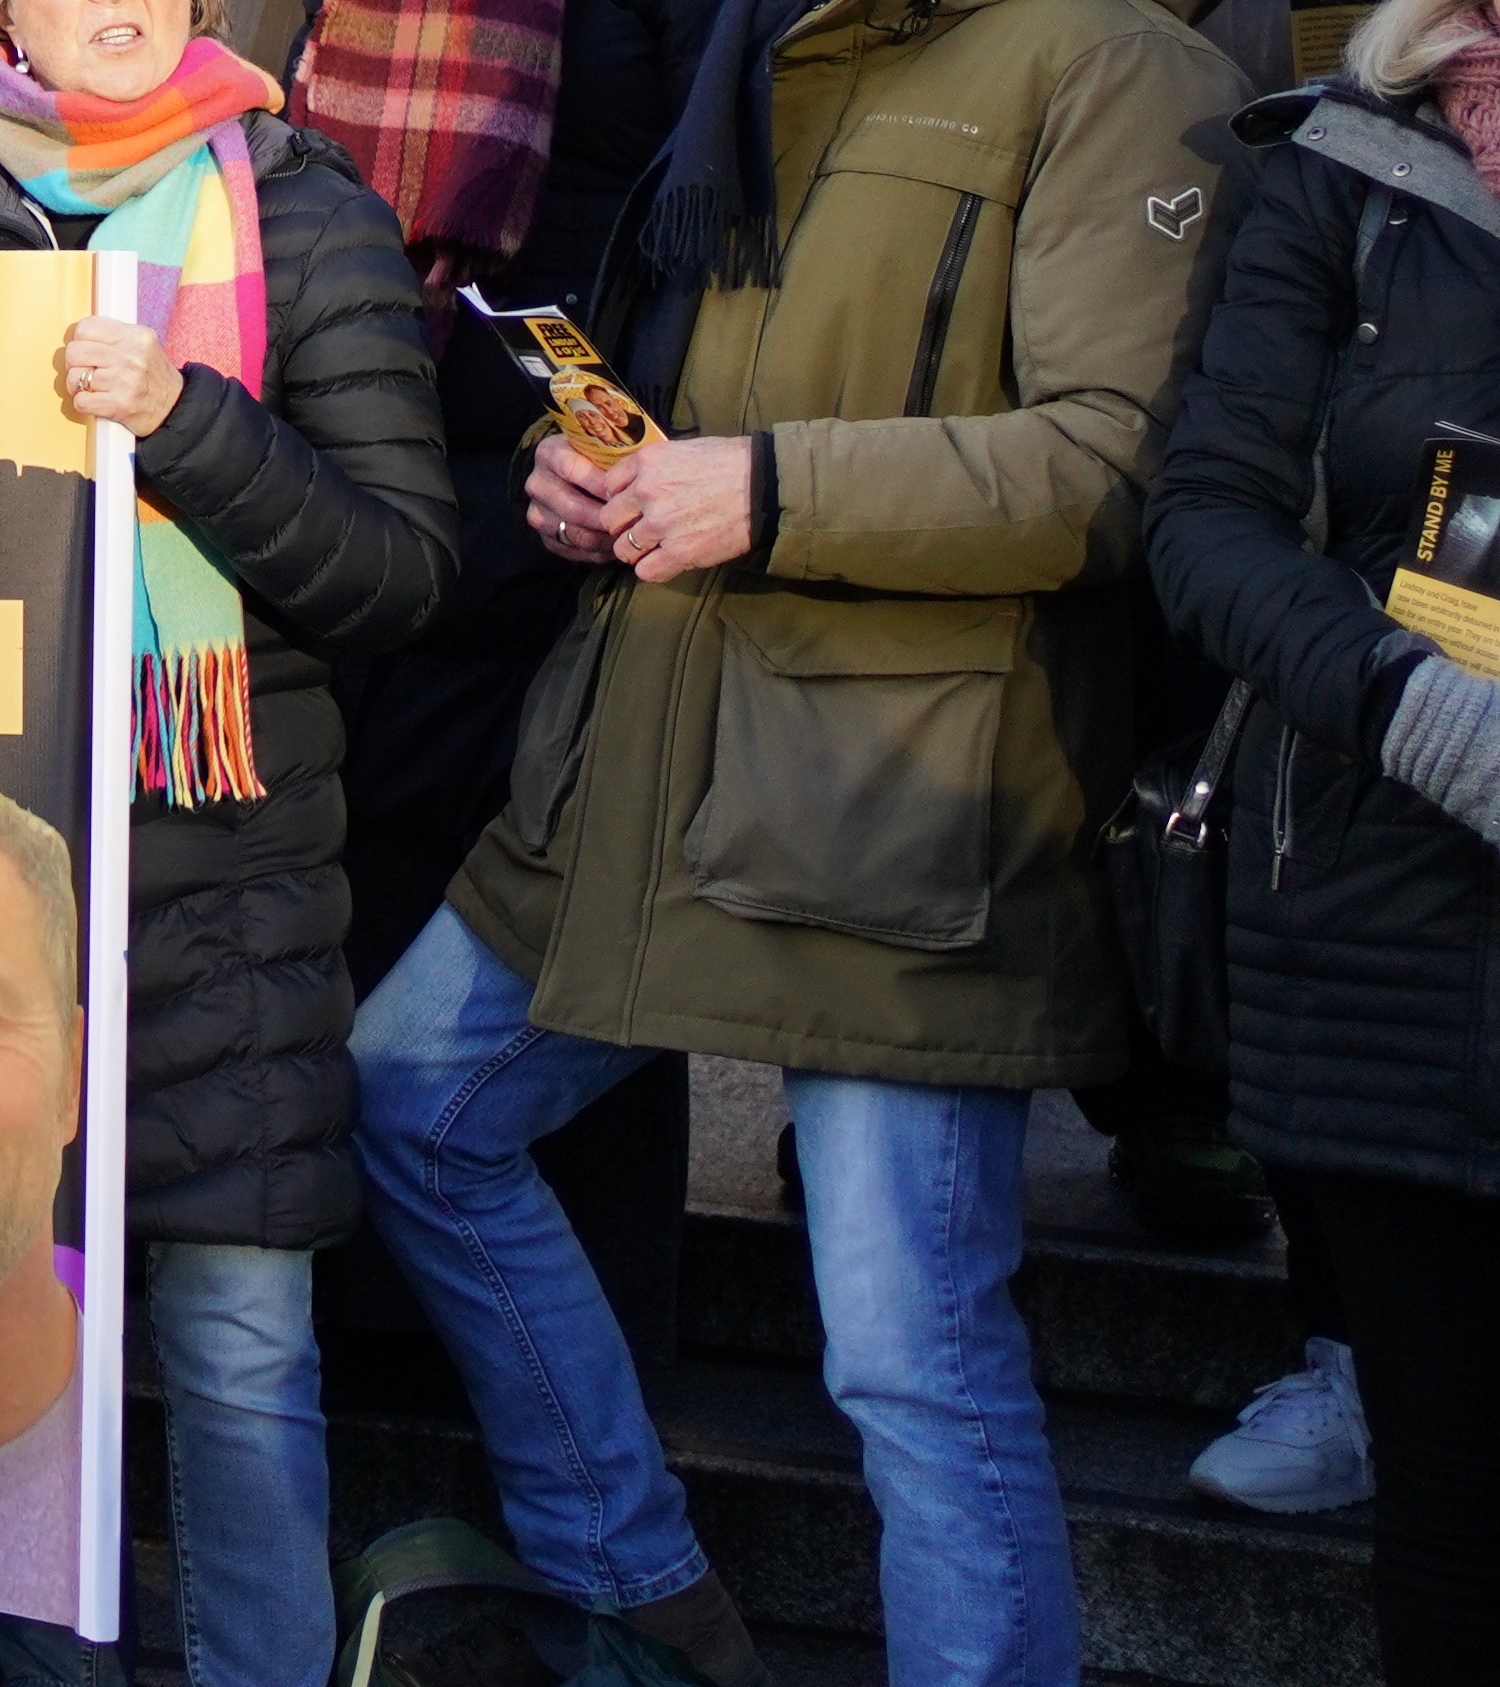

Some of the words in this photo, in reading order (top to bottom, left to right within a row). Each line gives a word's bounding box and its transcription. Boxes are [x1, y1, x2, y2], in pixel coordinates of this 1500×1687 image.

[536, 323, 574, 337] FREE
[1437, 449, 1454, 473] ME
[1430, 475, 1450, 499] BY
[1417, 501, 1444, 562] STAND
